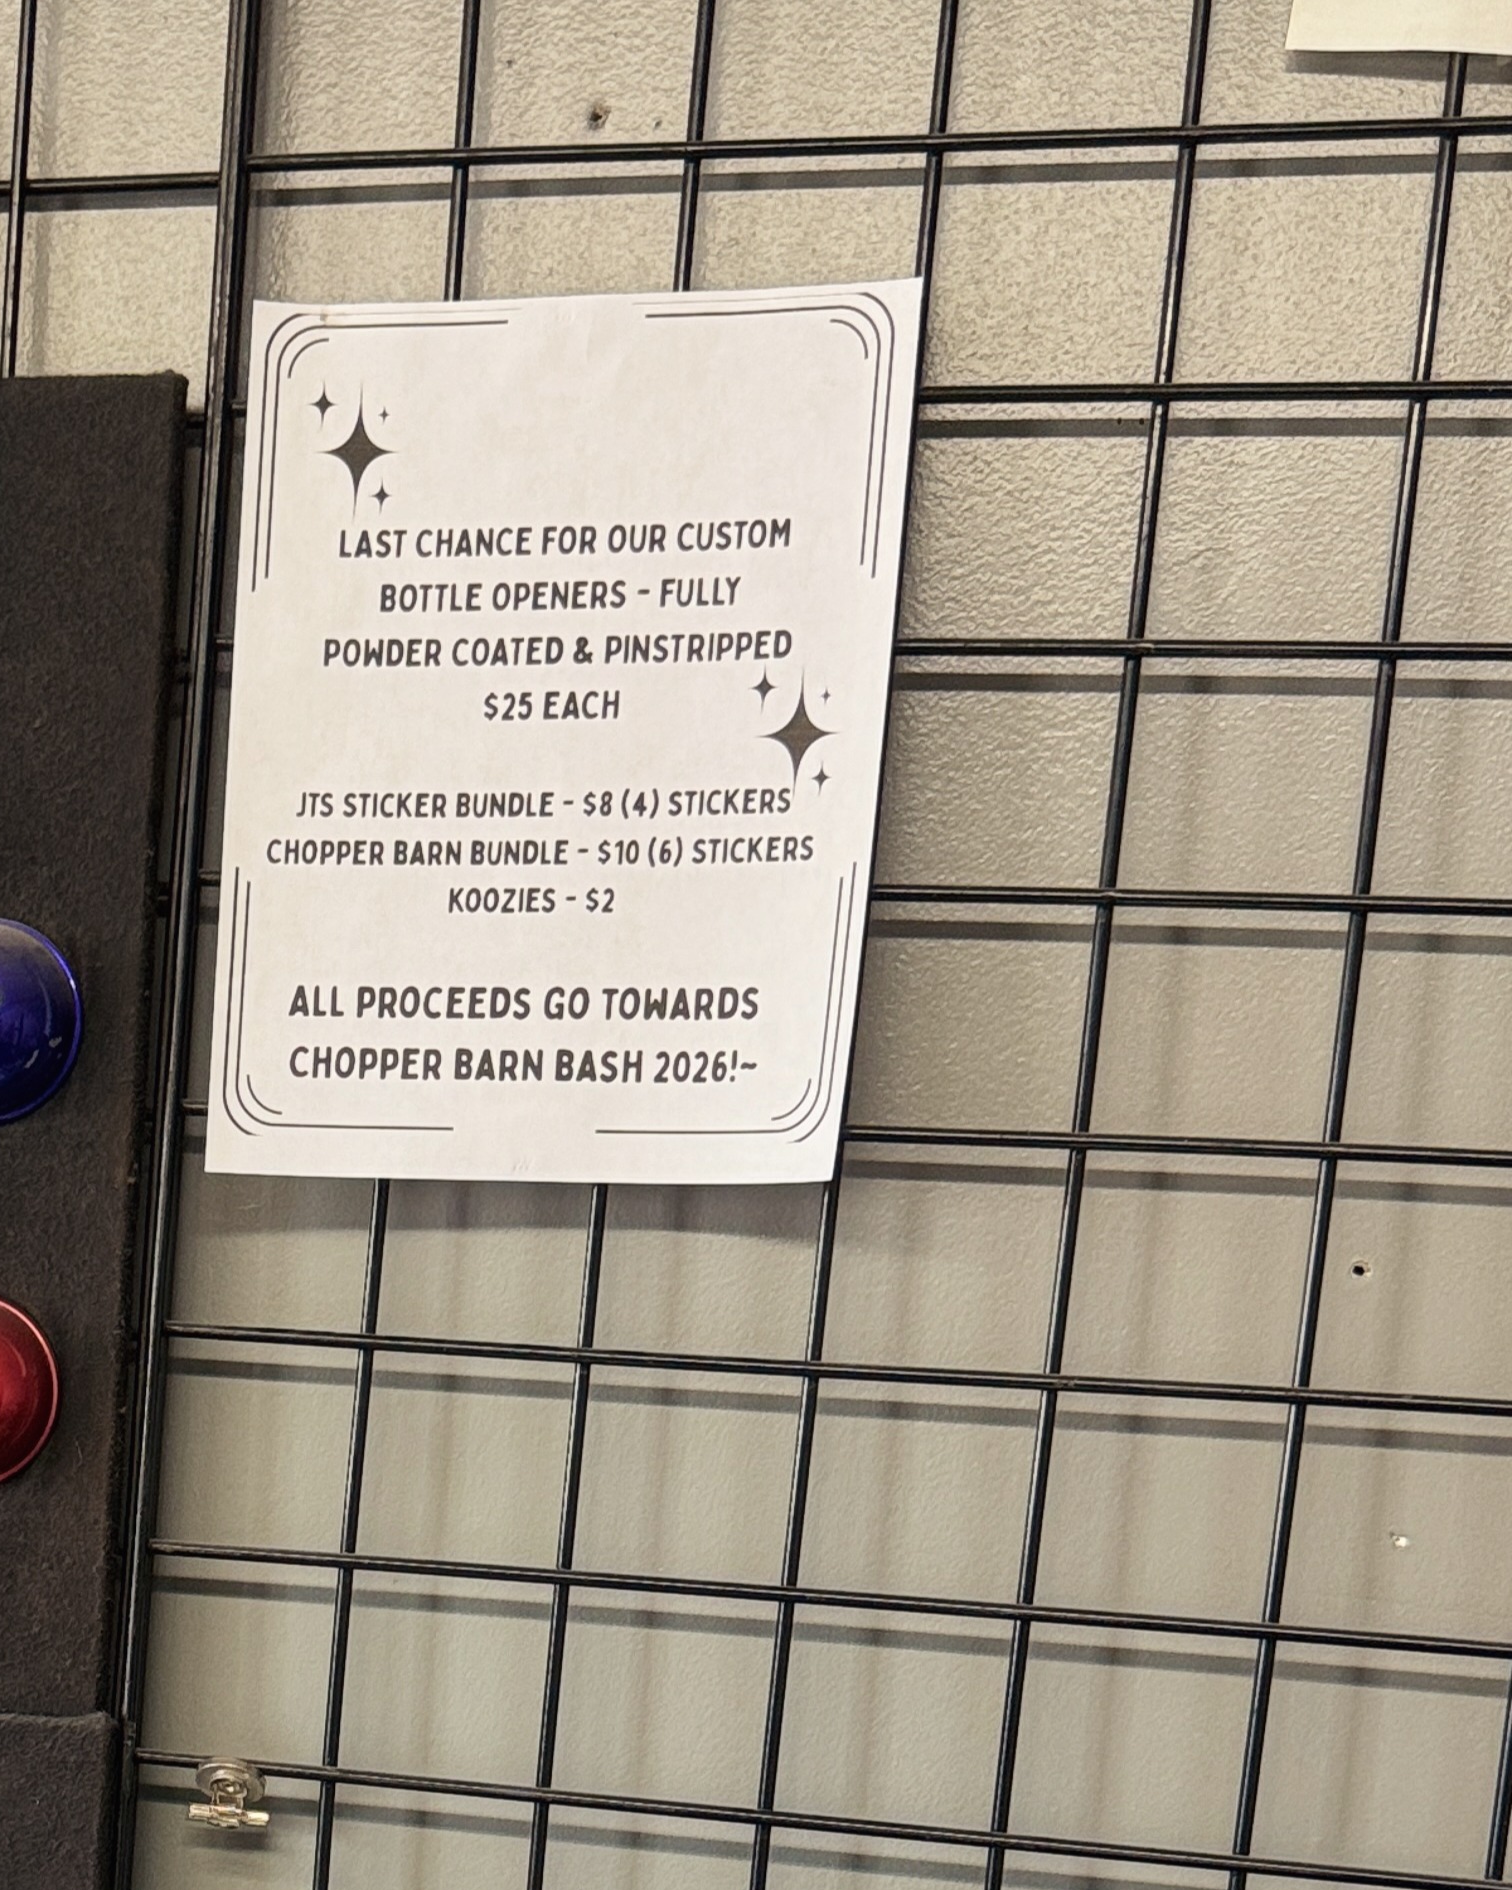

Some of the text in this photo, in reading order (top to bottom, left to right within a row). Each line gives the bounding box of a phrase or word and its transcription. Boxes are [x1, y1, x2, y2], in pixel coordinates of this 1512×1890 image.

[340, 519, 790, 557] LAST CHANCE FOR OUR CUSTOM
[381, 584, 482, 611] BOTTLE
[493, 581, 625, 610] OPENERS
[661, 577, 740, 606] FULLY
[324, 630, 791, 666] POWDER COATED & PINSTRIPPED
[485, 691, 619, 720] $25 EACH
[297, 793, 333, 816] JTS
[344, 793, 446, 817] STICKER
[456, 793, 554, 817] BUNDLE
[584, 791, 612, 816] $8
[622, 789, 658, 818] (4)
[669, 789, 790, 816] STICKERS
[267, 840, 383, 865] CHOPPER
[394, 841, 461, 865] BARN
[471, 840, 568, 865] BUNDLE
[599, 840, 639, 864] $10
[649, 837, 682, 866] (6)
[693, 836, 812, 863] STICKERS
[449, 888, 555, 912] KOOZIES
[587, 888, 614, 912] $2
[289, 986, 758, 1020] ALL PROCEEDS GO TOWARDS
[290, 1047, 756, 1082] CHOPPER BARN BASH 2026!~
